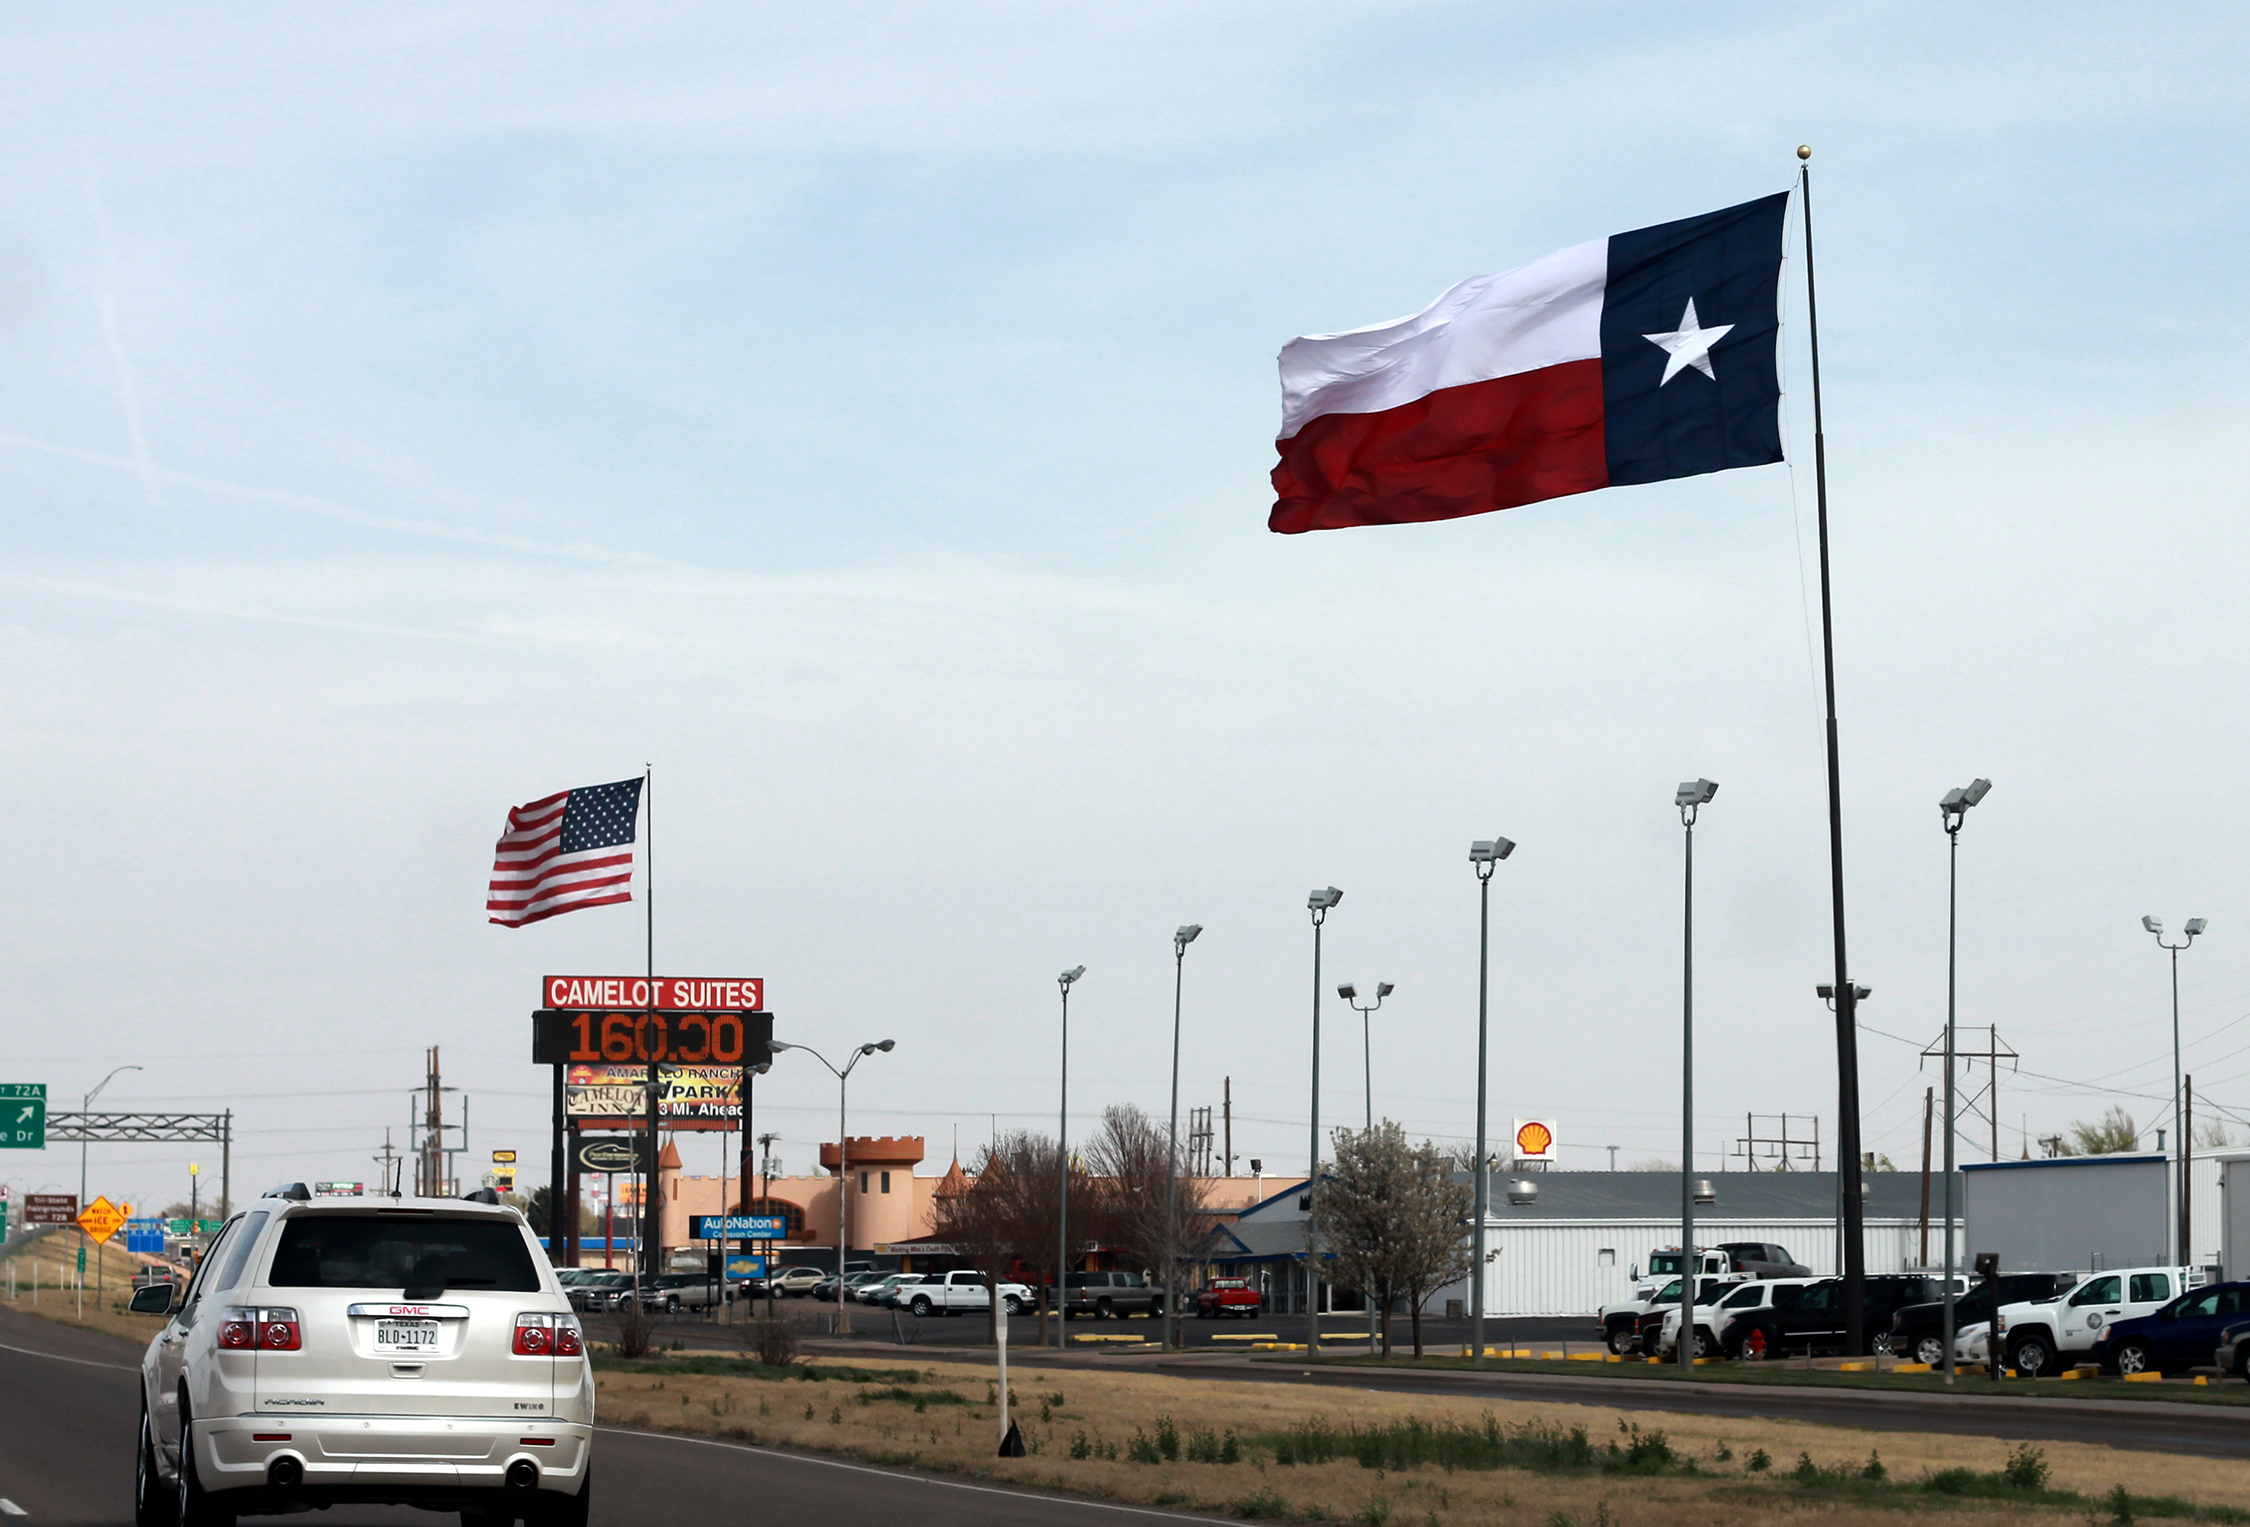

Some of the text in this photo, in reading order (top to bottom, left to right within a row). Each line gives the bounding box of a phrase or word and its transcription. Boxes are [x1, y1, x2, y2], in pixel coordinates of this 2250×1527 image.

[551, 979, 757, 1007] CAMELOT SUITES
[688, 1068, 741, 1079] RANCH
[14, 1085, 41, 1096] 72A
[672, 1086, 731, 1099] PARK
[589, 1103, 623, 1113] INN
[672, 1102, 694, 1116] Mi.
[16, 1130, 34, 1142] Dr
[94, 1216, 109, 1225] ICE
[712, 1230, 772, 1238] Coision Center
[389, 1306, 430, 1315] GMC
